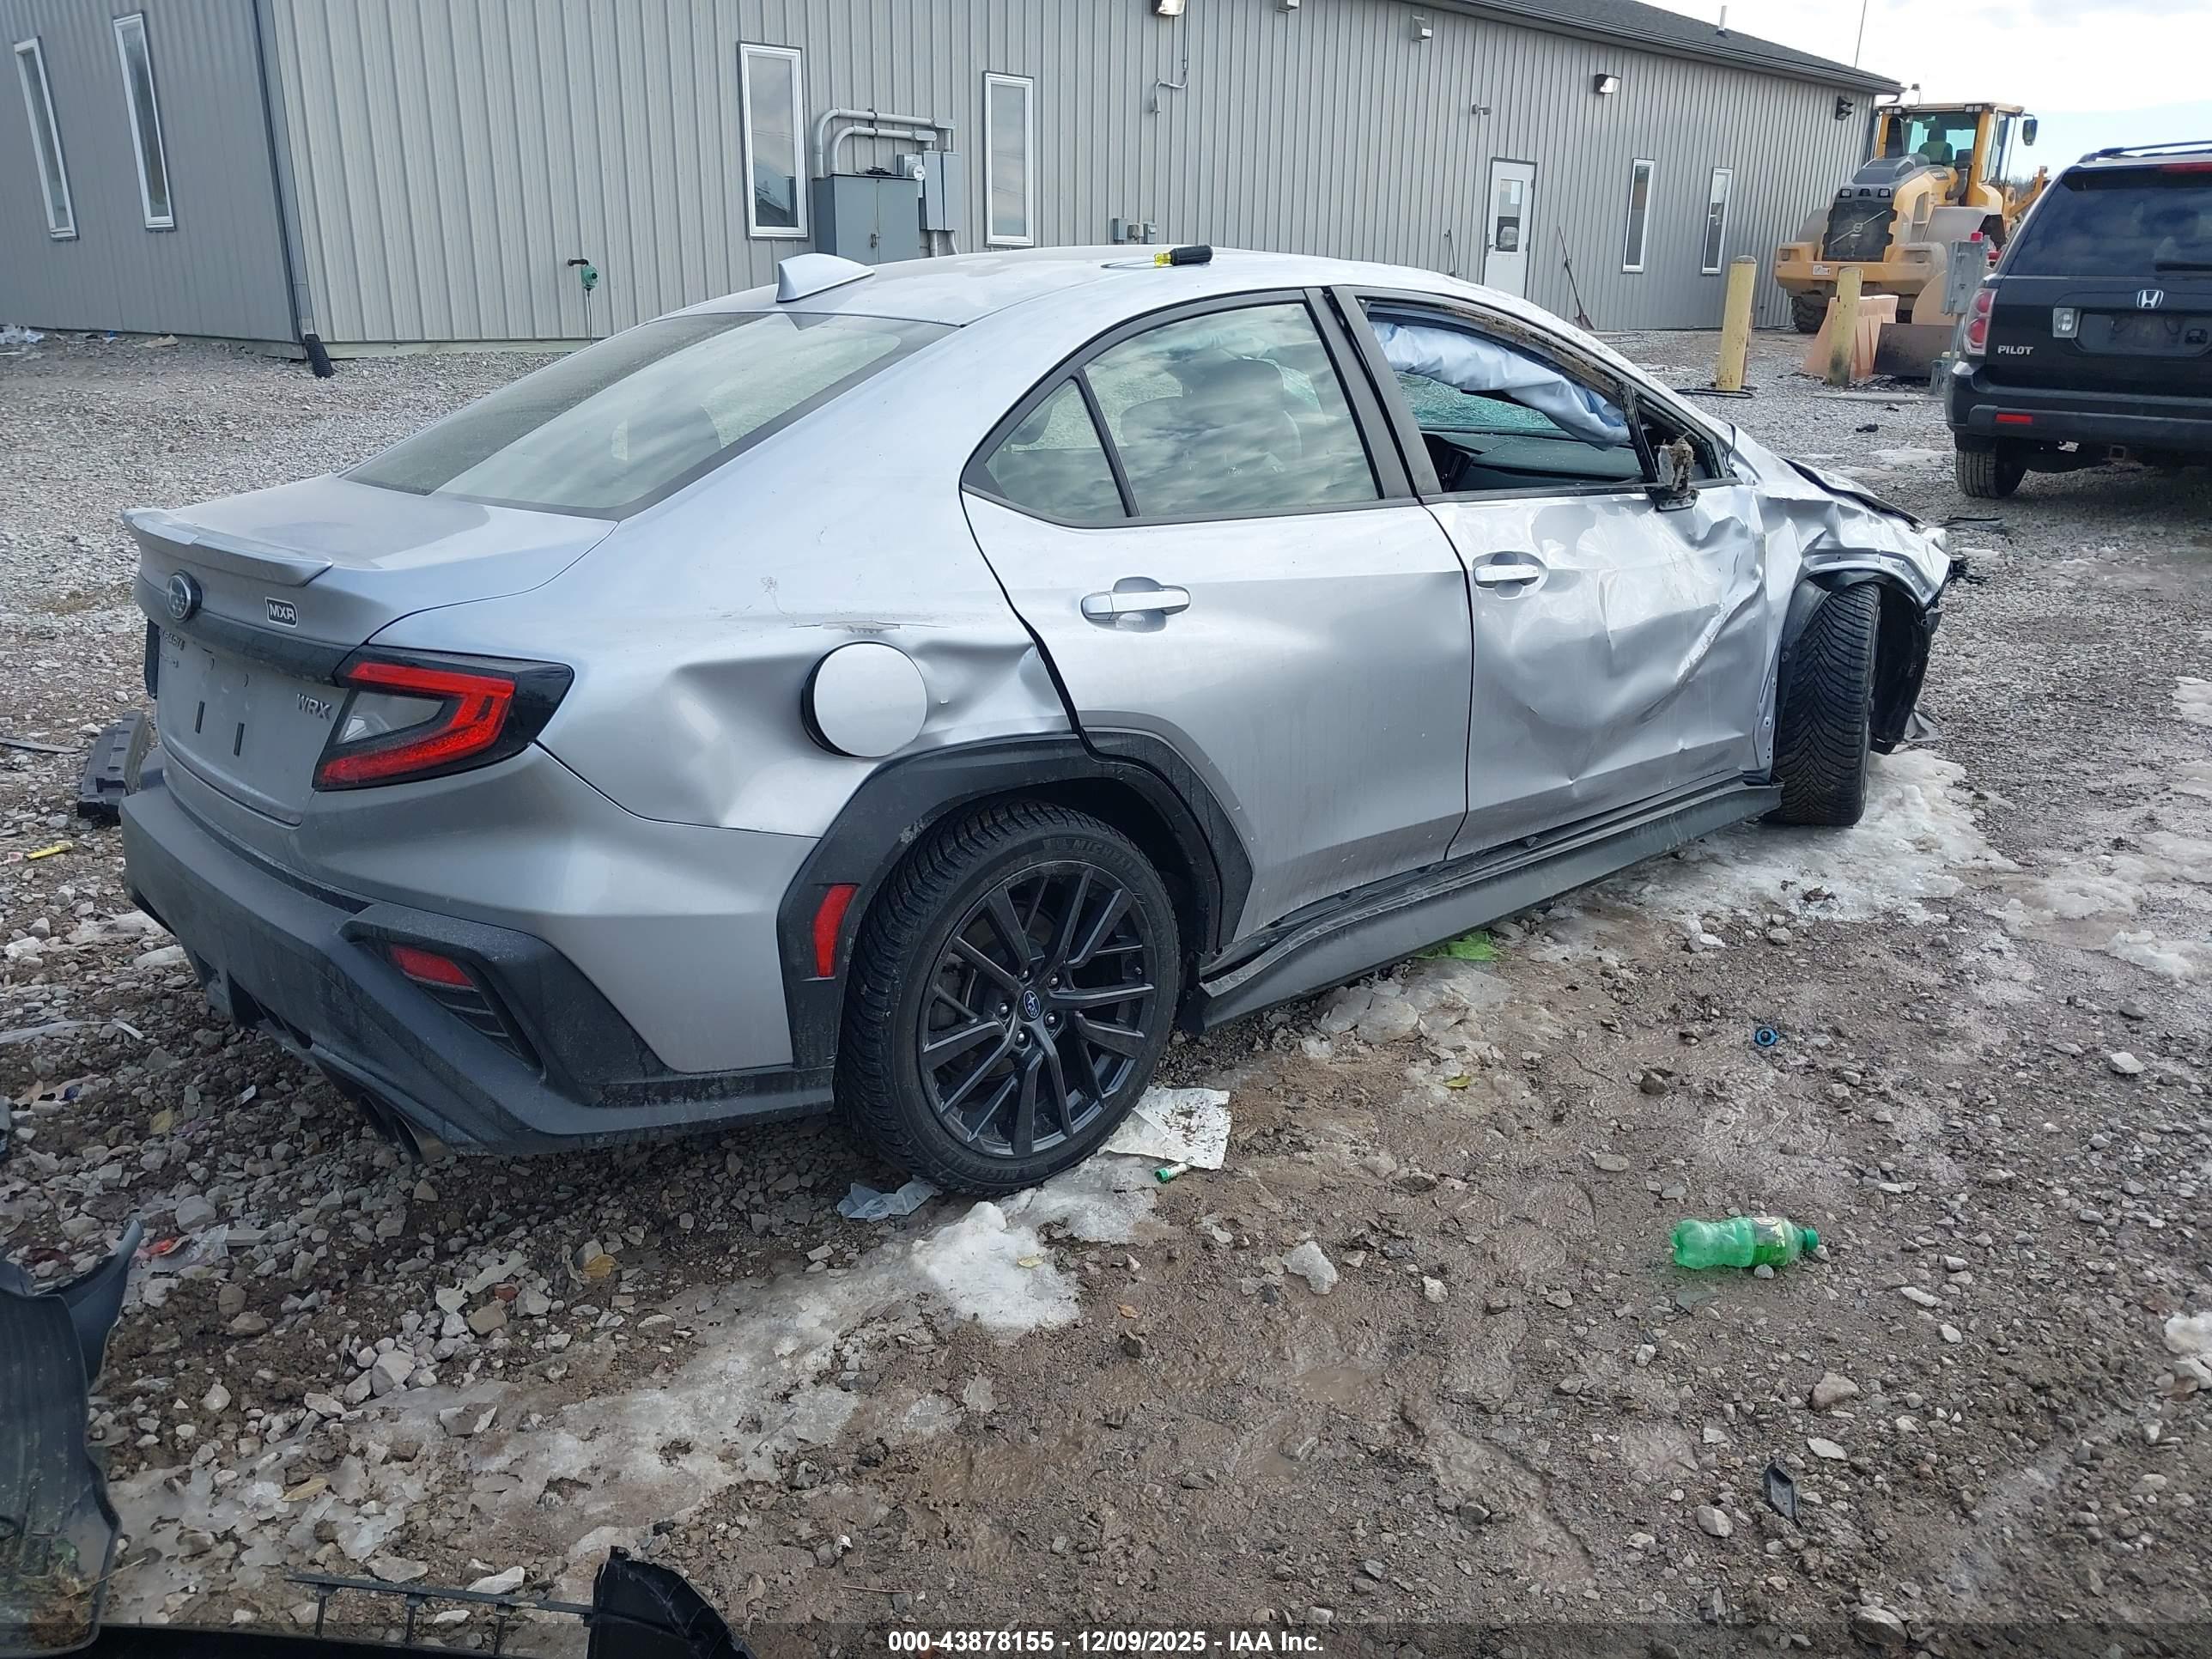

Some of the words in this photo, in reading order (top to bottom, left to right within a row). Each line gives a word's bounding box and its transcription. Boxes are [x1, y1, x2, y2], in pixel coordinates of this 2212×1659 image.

[1996, 344, 2034, 356] PILOT
[269, 603, 296, 622] MXR
[296, 693, 331, 720] WRX
